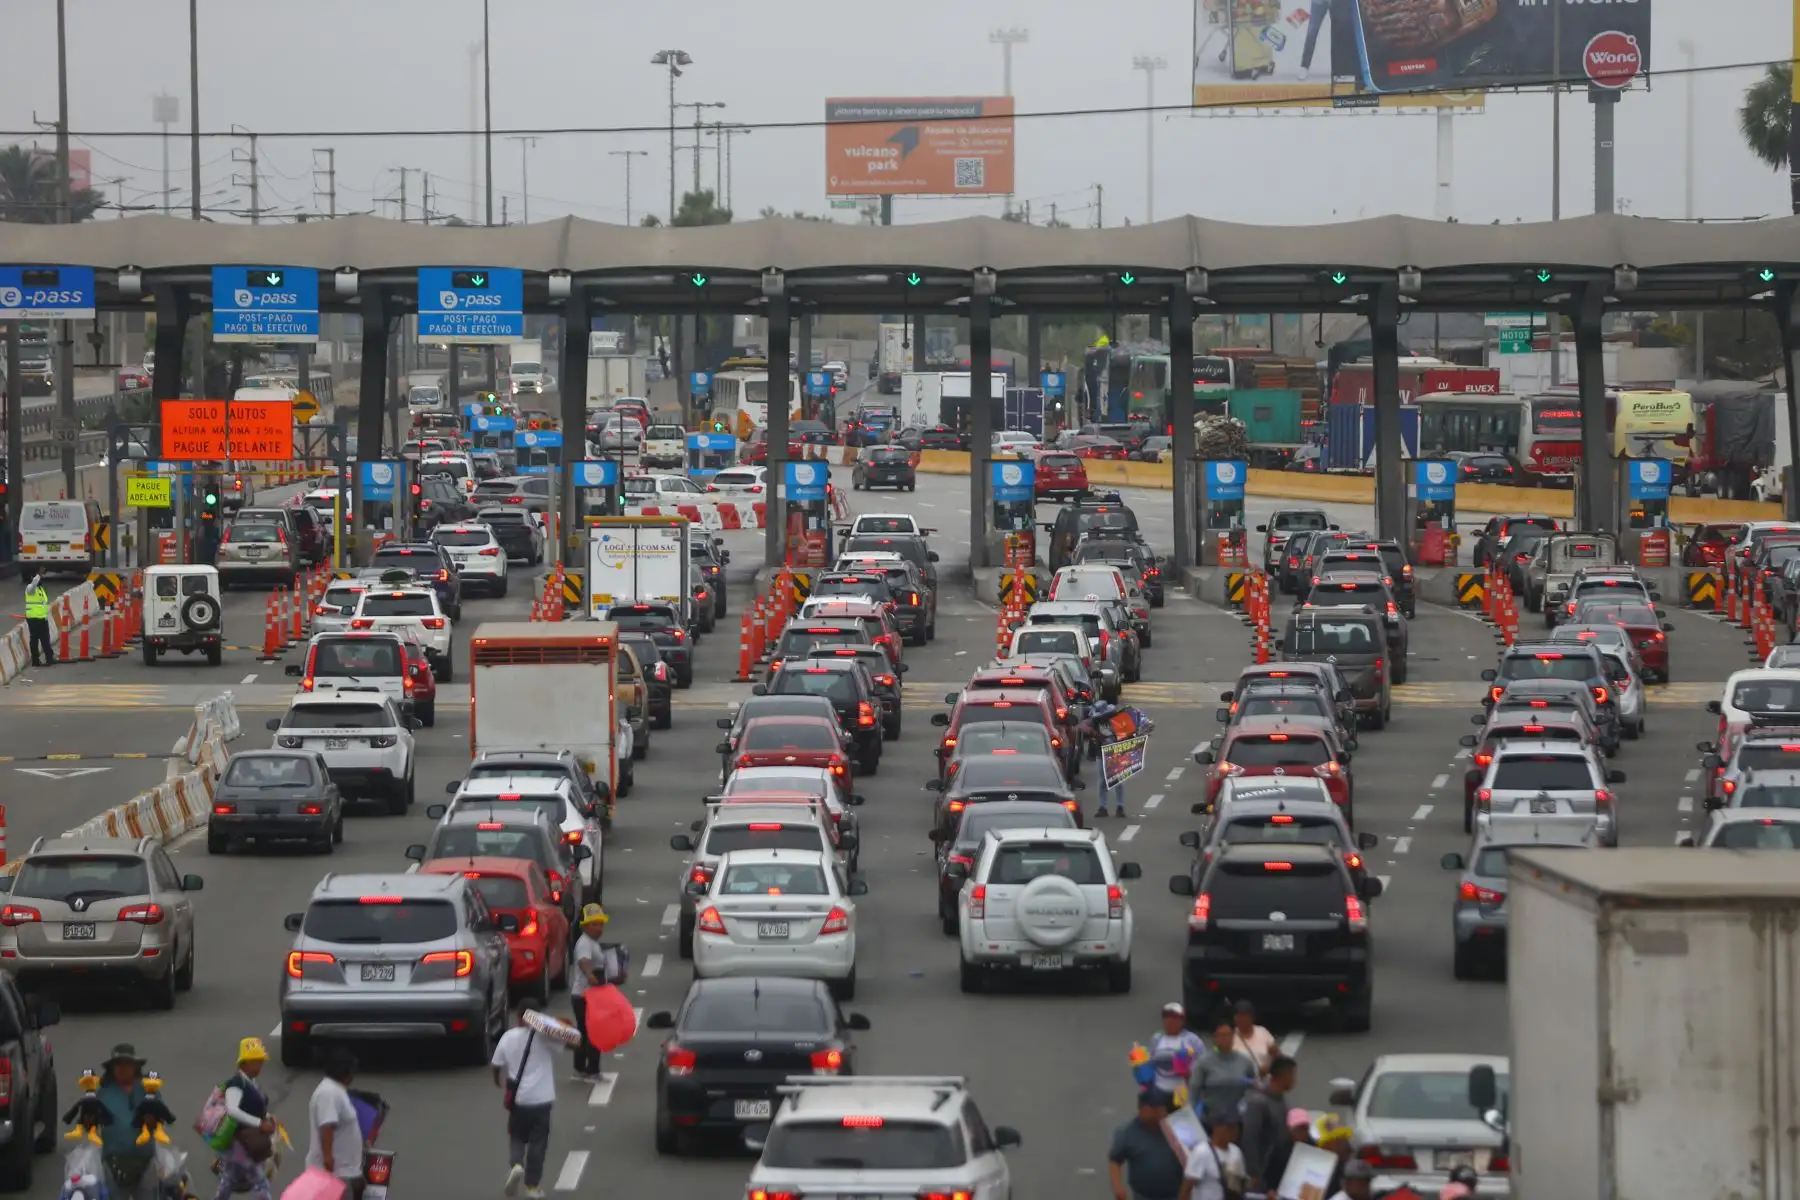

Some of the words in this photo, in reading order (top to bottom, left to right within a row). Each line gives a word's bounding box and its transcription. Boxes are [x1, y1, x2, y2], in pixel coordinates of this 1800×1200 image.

[844, 145, 898, 157] vulcano
[867, 158, 898, 172] park
[239, 313, 293, 322] POST-PAGO
[443, 315, 497, 324] POST-PAGO
[224, 323, 248, 333] PAGO
[252, 323, 264, 333] EN
[267, 323, 308, 333] EFECTIVO
[429, 324, 453, 334] PAGO
[456, 324, 468, 334] EN
[471, 324, 512, 334] EFECTIVO
[1502, 330, 1529, 340] MOTOS
[1465, 384, 1495, 392] ELVEX
[187, 408, 218, 420] SOLO
[229, 407, 267, 420] AUTOS
[172, 426, 206, 435] ALTURA
[173, 441, 209, 453] PAGUE
[218, 441, 281, 453] ADELANTE
[136, 482, 161, 490] PAGUE
[130, 493, 168, 501] ADELANTE
